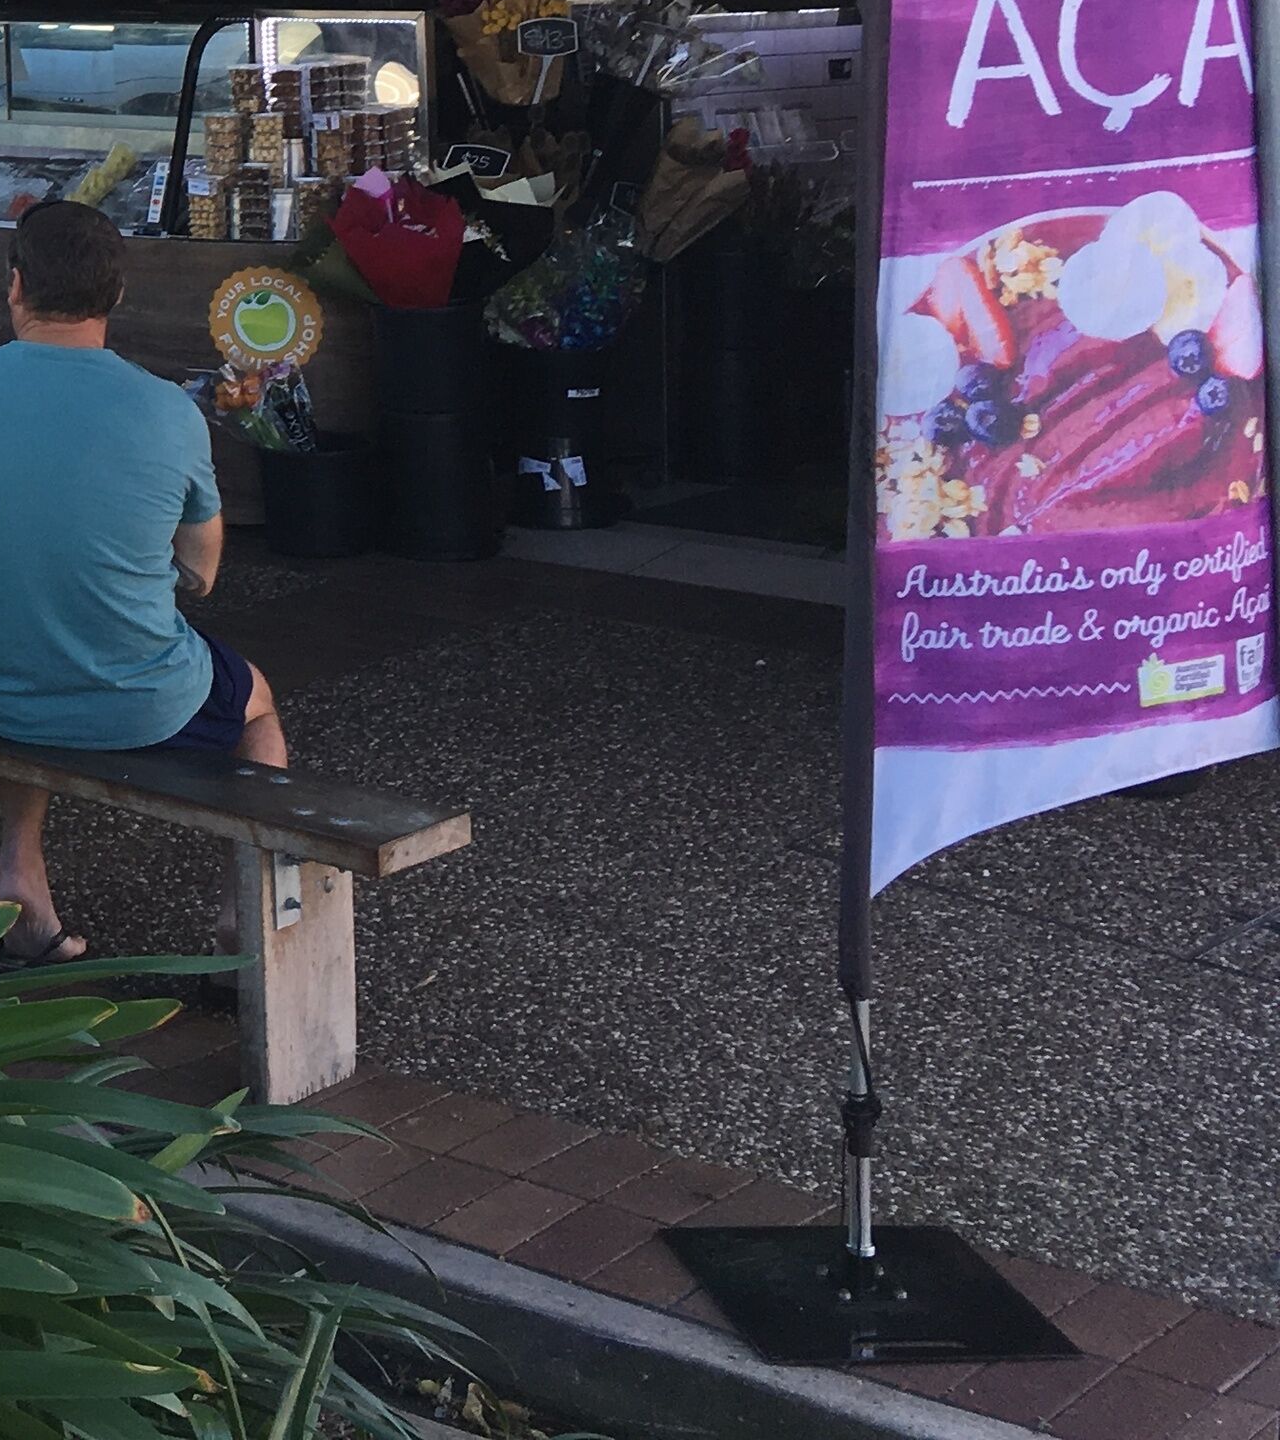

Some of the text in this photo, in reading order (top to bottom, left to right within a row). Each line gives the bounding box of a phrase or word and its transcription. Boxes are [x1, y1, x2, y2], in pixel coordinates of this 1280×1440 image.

[217, 280, 246, 319] YOUR
[250, 275, 304, 303] LOCAL
[282, 314, 317, 365] SHOP
[897, 525, 1268, 600] Australia's only certified
[900, 611, 973, 662] fair
[979, 611, 1071, 649] trade
[1078, 609, 1105, 641] &
[1114, 601, 1220, 648] organic
